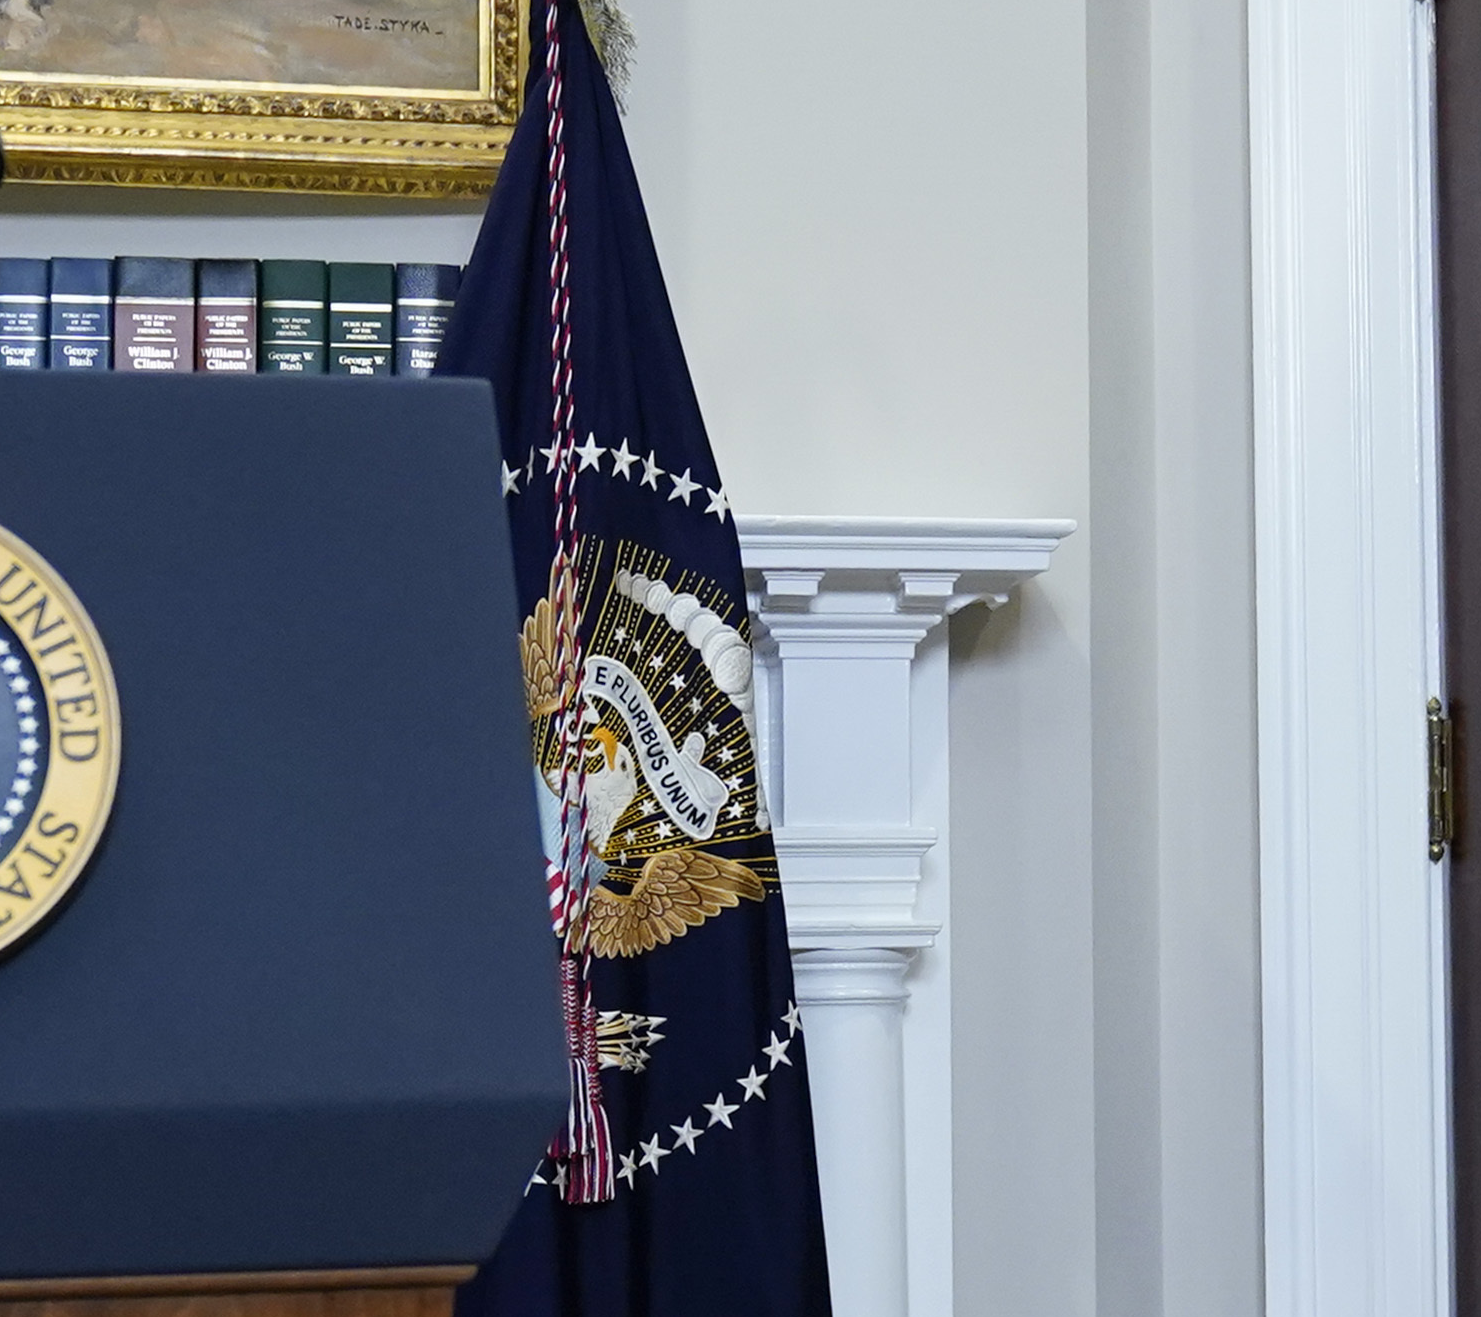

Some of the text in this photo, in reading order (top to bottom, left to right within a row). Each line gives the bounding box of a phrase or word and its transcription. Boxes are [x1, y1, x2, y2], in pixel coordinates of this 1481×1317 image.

[0, 345, 36, 358] George
[63, 345, 99, 357] George
[128, 346, 172, 358] William
[201, 347, 244, 359] William
[268, 351, 302, 362] George
[6, 356, 30, 367] Bush
[68, 356, 93, 367] Bush
[133, 358, 174, 370] Clinton
[206, 359, 248, 371] Clinton
[279, 361, 303, 371] Bush
[338, 355, 386, 366] George W.
[350, 365, 374, 375] Bush
[595, 666, 708, 829] E PLURIBUS UNUM
